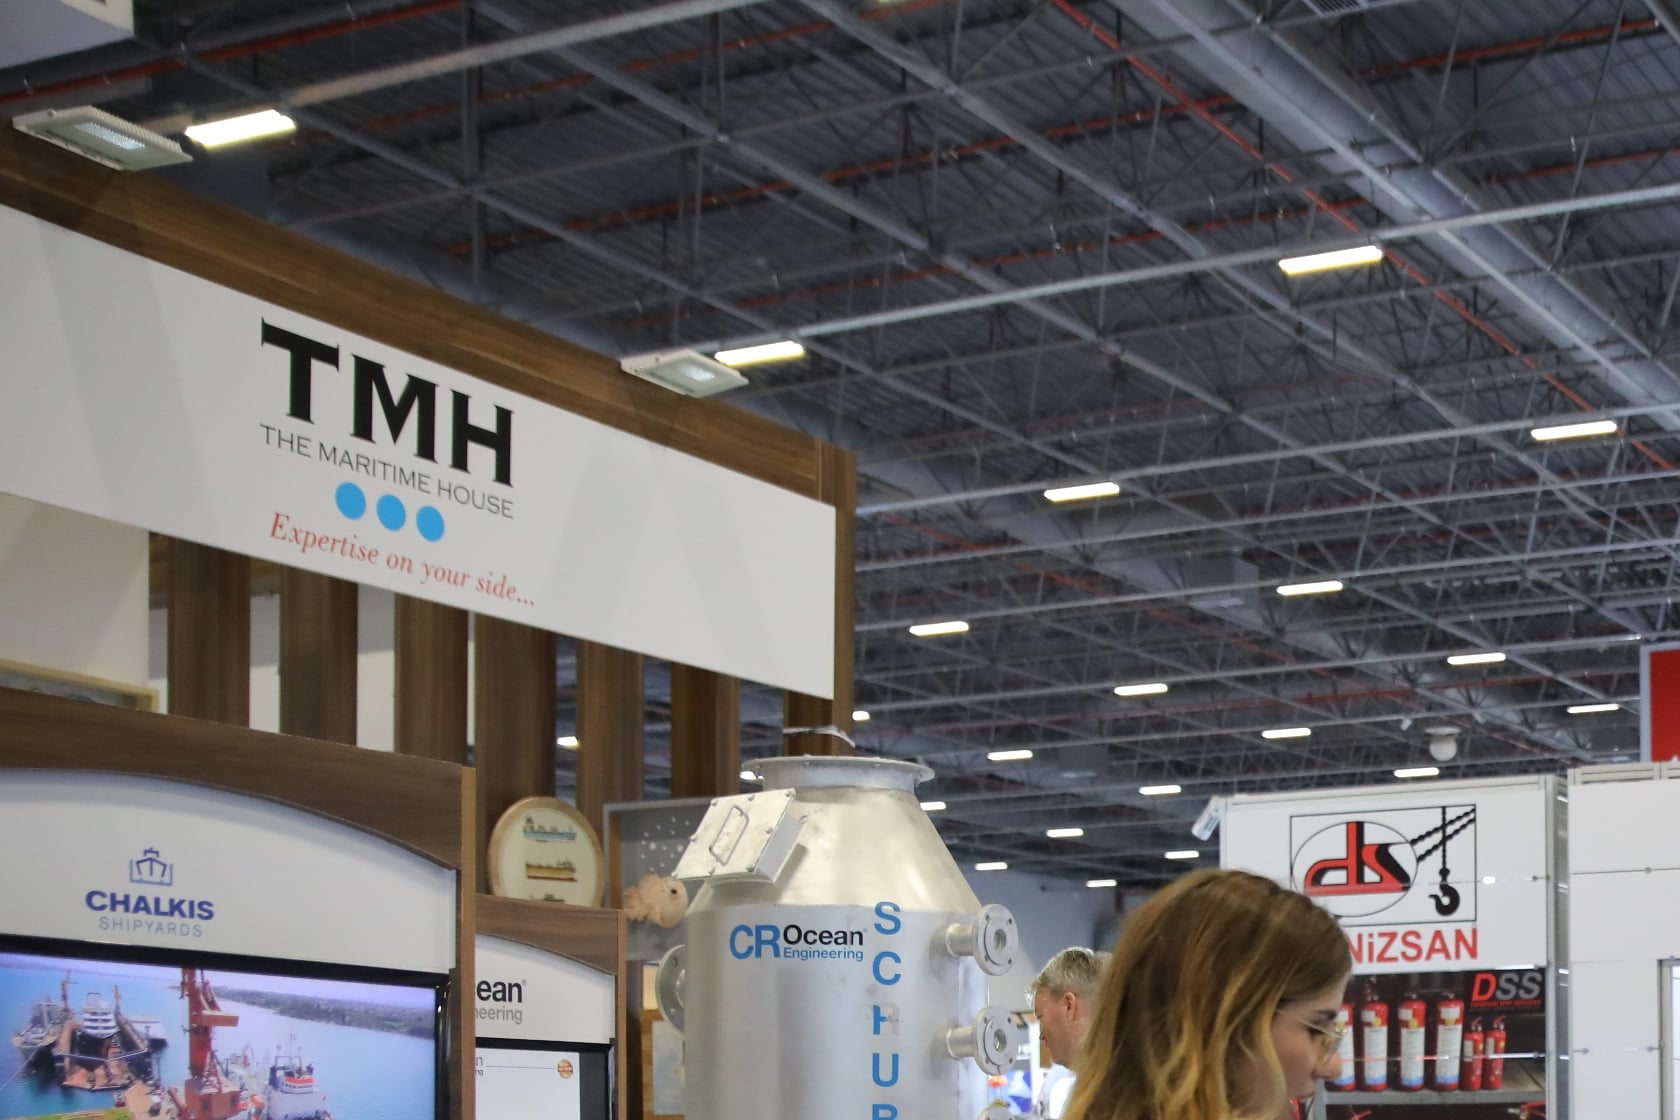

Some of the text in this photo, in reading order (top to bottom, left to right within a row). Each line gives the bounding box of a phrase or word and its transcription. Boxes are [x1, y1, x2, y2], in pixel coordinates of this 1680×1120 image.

[261, 316, 515, 488] TMH
[260, 422, 515, 520] THE MARITIME HOUSE
[269, 511, 536, 607] Expertise on your side...
[85, 890, 215, 921] CHALKIS
[98, 916, 203, 938] SHIPYARDS
[729, 924, 864, 960] CR Ocean
[783, 947, 864, 962] Engineering
[1472, 972, 1543, 1002] DSS
